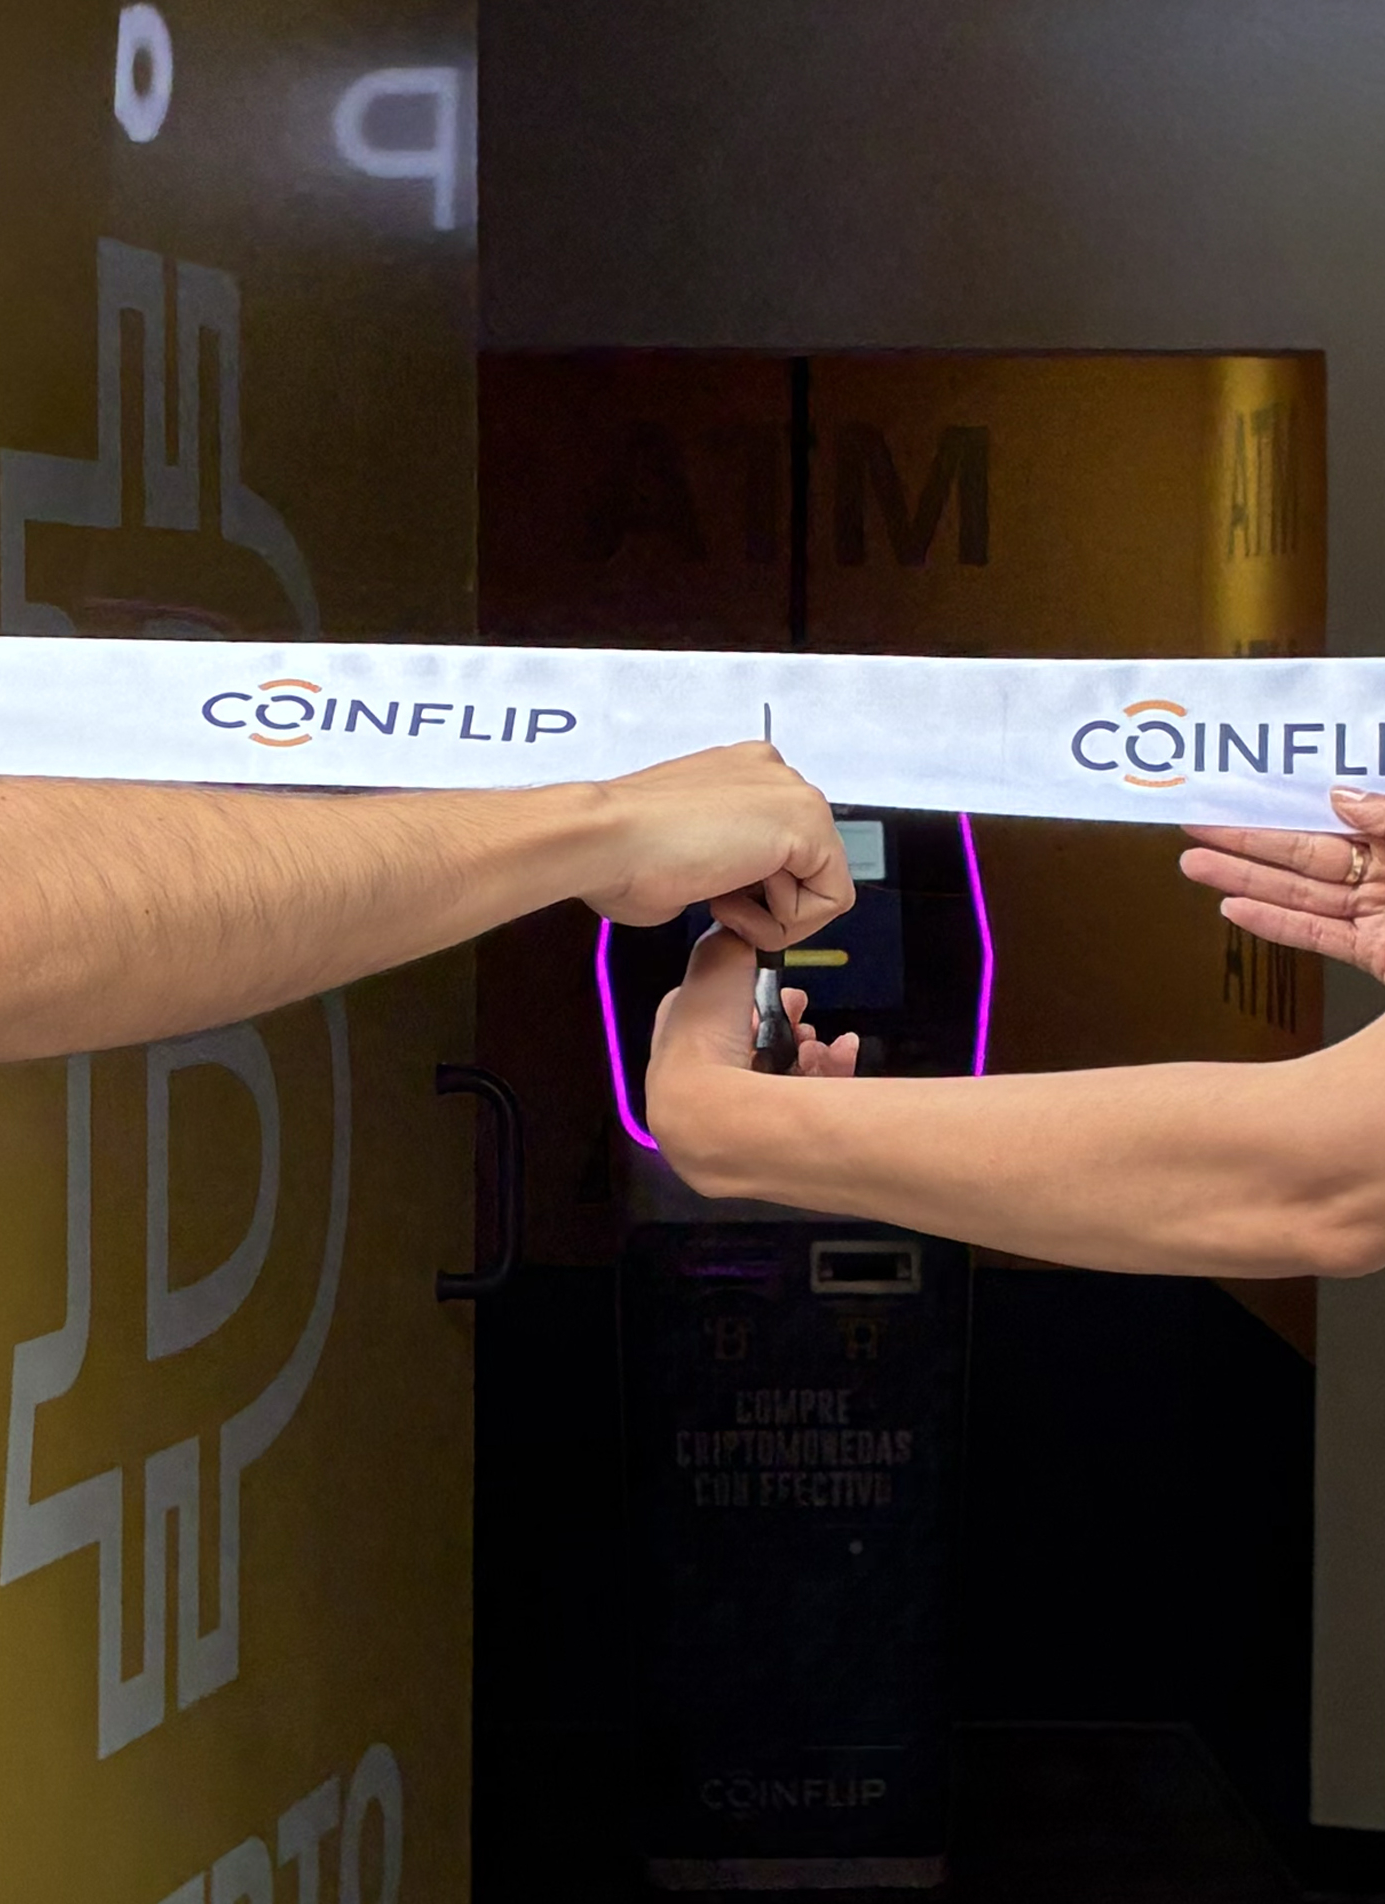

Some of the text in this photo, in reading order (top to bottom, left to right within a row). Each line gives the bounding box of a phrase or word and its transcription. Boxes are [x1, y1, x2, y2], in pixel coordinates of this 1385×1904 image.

[201, 679, 577, 748] COINFLIP
[735, 1388, 851, 1425] COMPRE
[700, 1770, 887, 1819] COINFLIP
